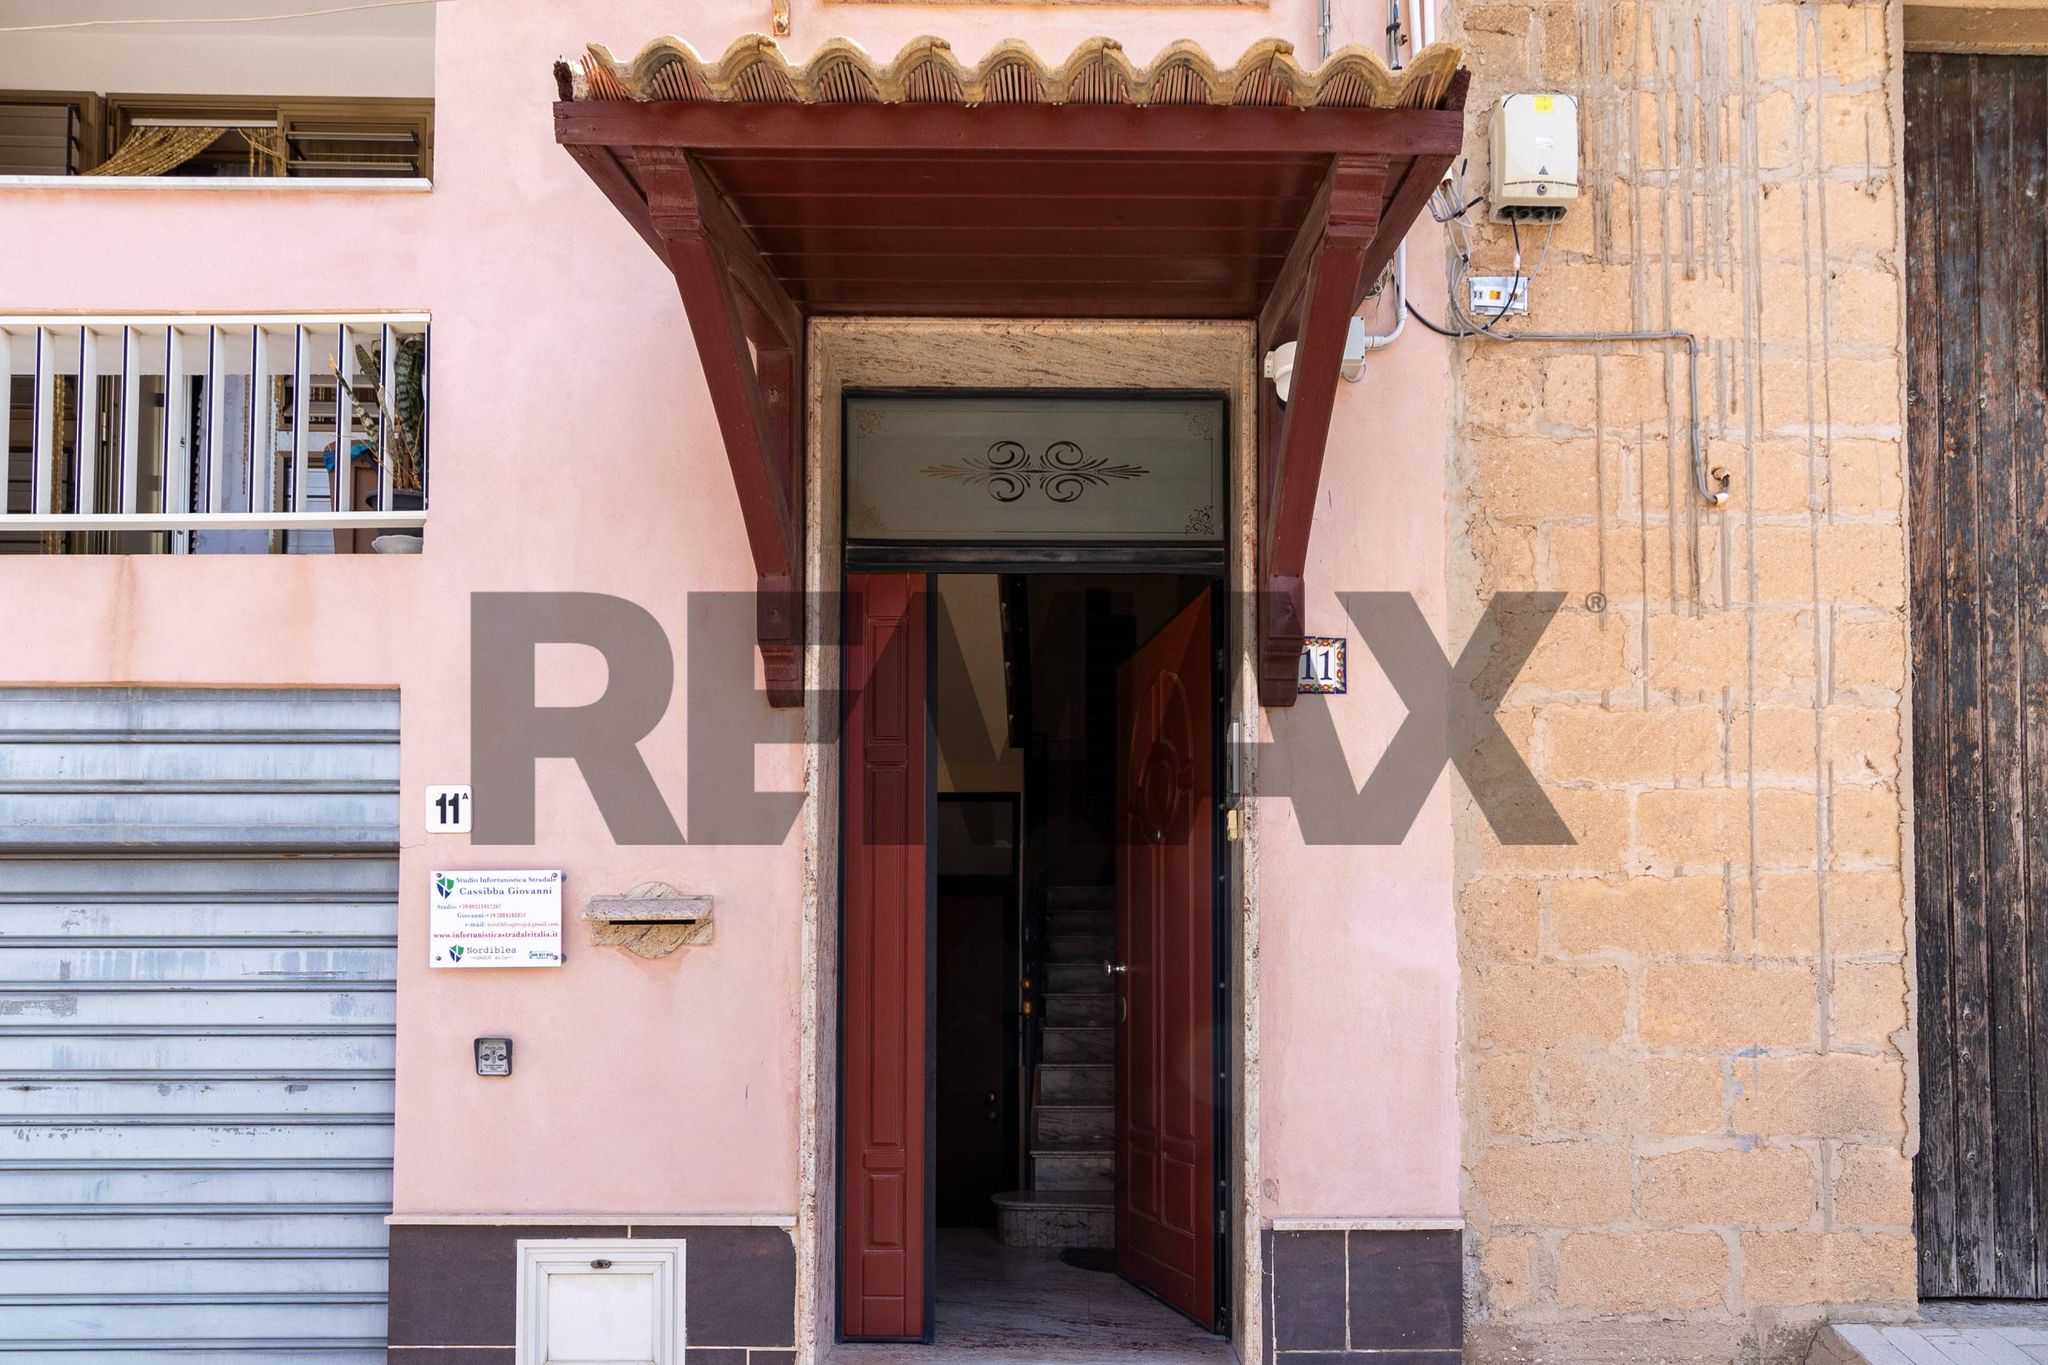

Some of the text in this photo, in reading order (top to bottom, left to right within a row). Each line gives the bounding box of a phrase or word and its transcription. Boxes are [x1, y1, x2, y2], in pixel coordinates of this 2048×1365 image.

[1301, 649, 1333, 681] 11
[480, 876, 527, 884] Infortunistica
[528, 876, 558, 884] Stradale
[459, 886, 553, 896] Cassibba Giovanni
[466, 945, 518, 954] Nordiblea
